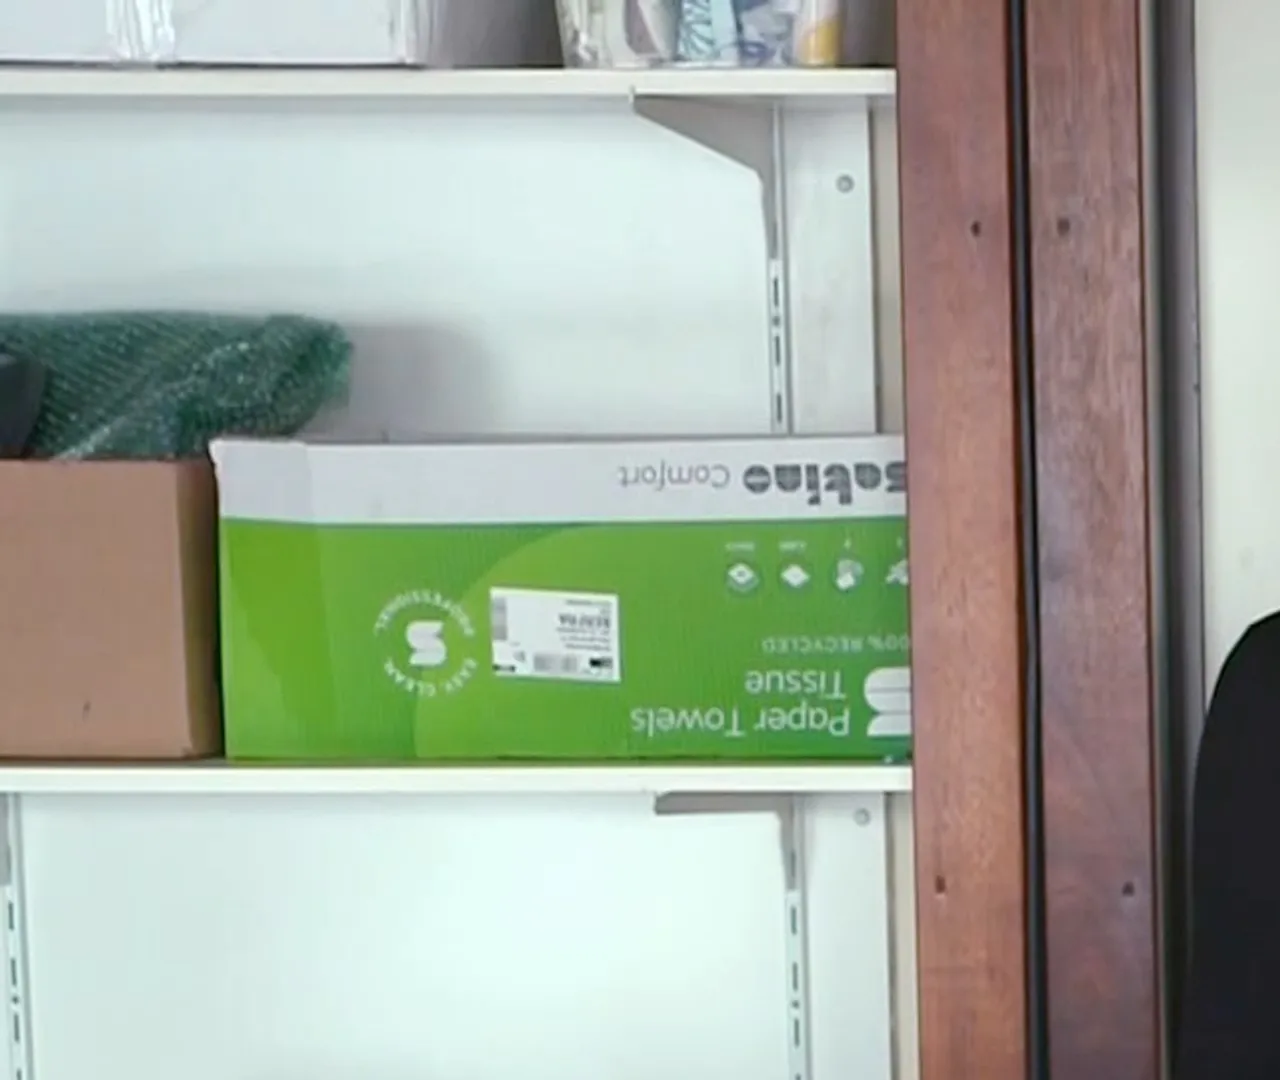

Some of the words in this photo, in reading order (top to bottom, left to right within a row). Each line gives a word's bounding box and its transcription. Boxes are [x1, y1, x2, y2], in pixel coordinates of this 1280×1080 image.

[618, 460, 731, 491] Comfort
[744, 668, 847, 700] Tissue
[630, 704, 746, 738] Towels
[752, 698, 851, 737] Paper
